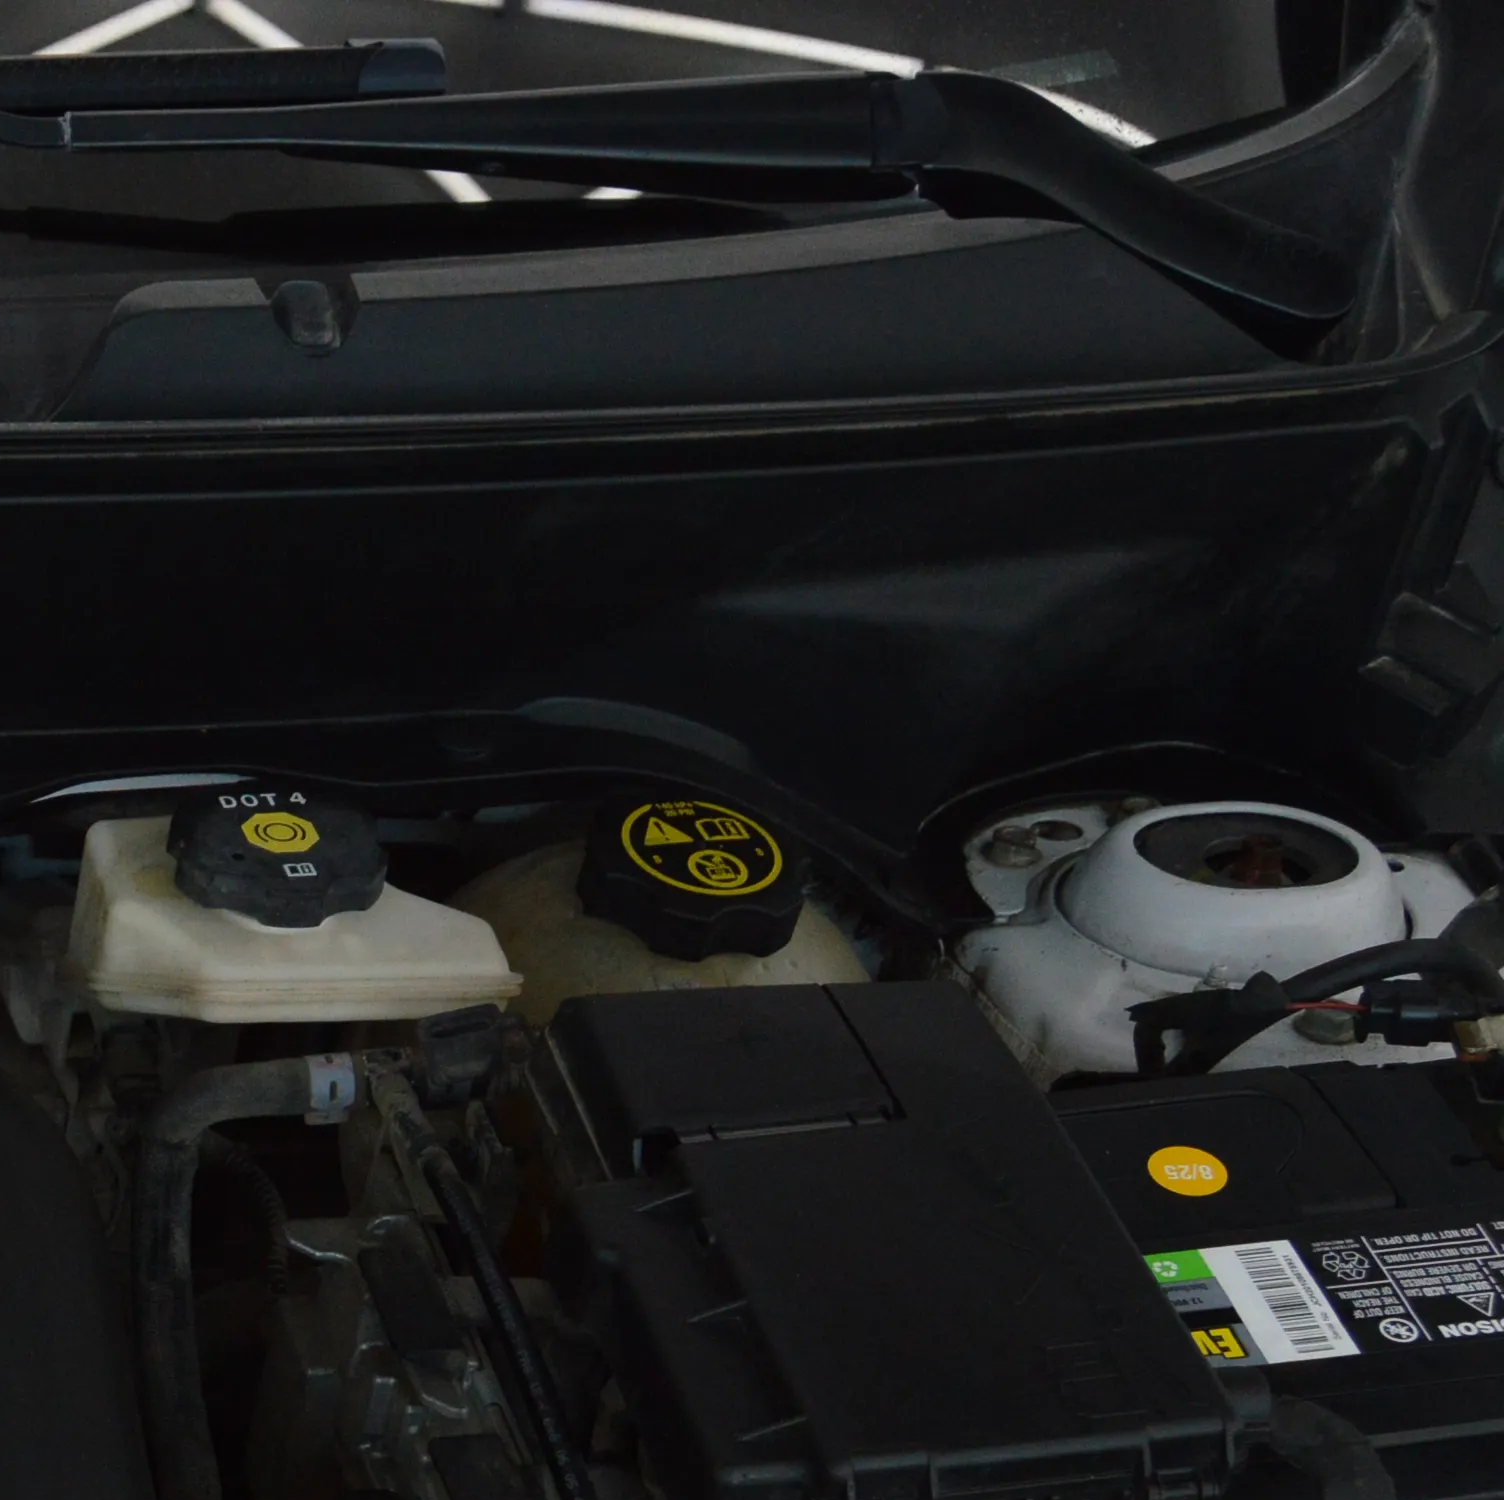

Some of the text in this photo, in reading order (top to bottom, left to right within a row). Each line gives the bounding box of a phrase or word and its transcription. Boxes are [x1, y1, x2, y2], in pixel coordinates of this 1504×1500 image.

[217, 791, 308, 809] DOT 4
[1162, 1162, 1215, 1182] 8/25
[1420, 1232, 1438, 1243] TIP
[1459, 1244, 1490, 1256] READ
[1380, 1286, 1393, 1296] OF
[1381, 1296, 1401, 1306] THE
[1352, 1305, 1406, 1319] KEEP OUT OF
